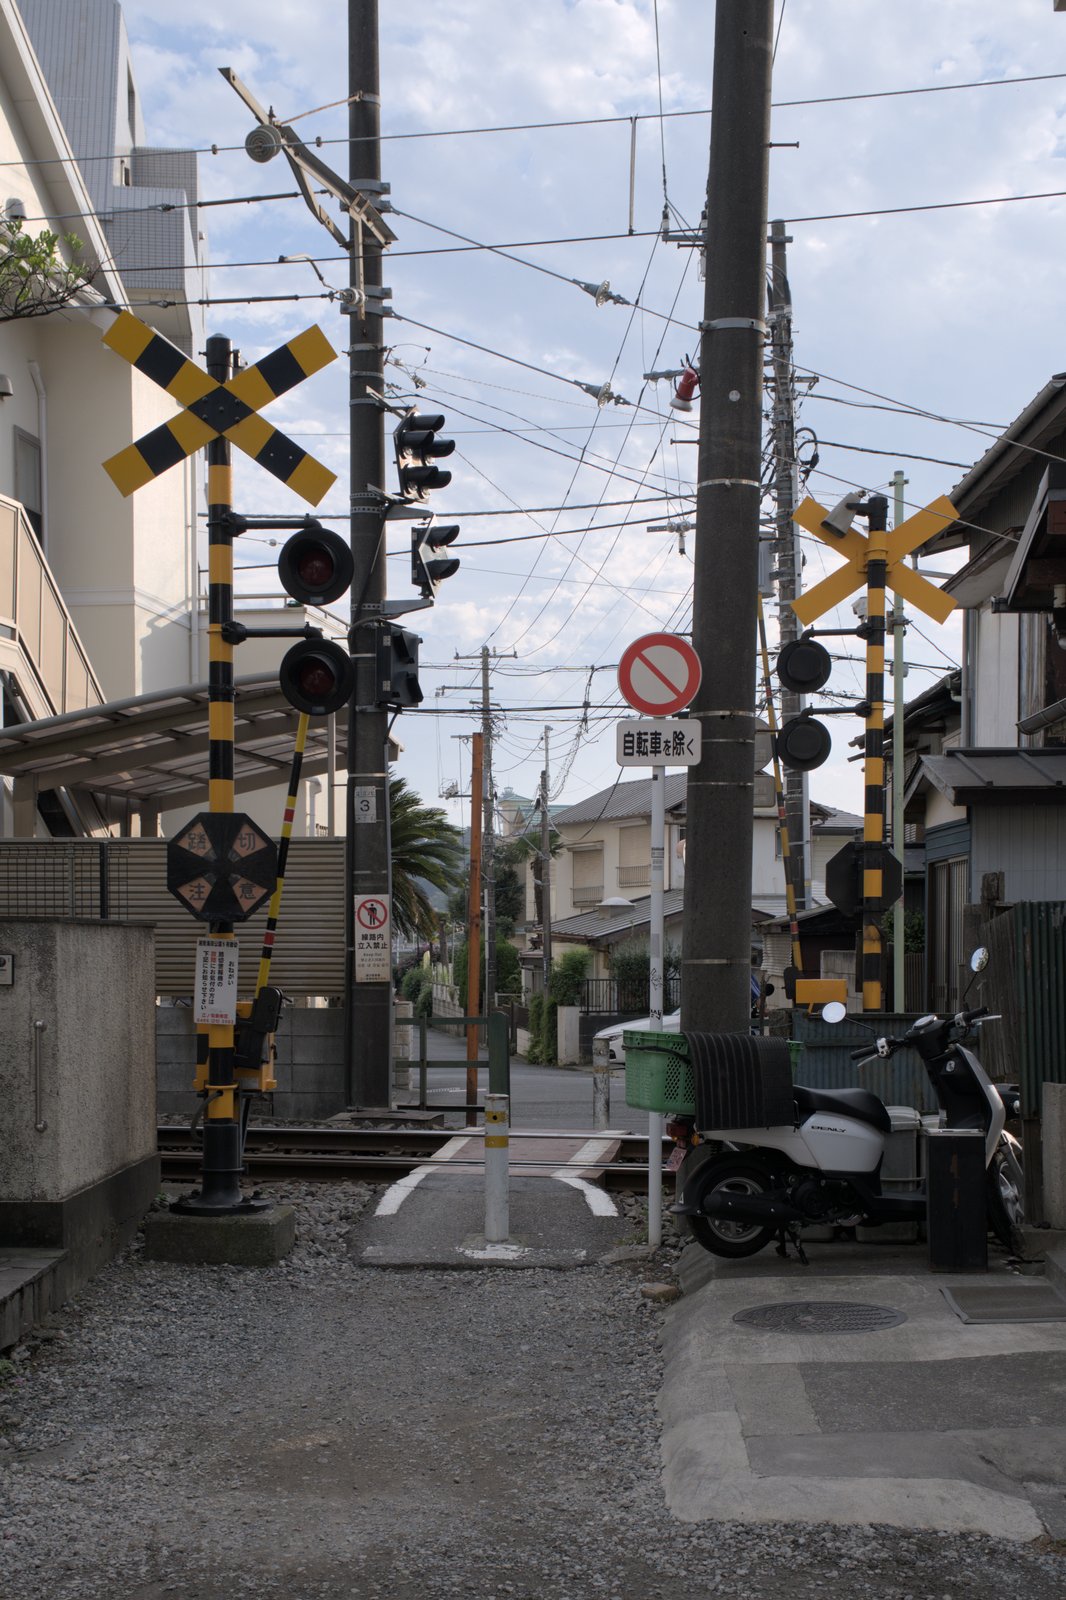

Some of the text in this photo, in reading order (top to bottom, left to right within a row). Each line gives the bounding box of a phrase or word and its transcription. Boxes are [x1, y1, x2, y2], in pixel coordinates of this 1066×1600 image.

[623, 730, 694, 757] 自転車を除く
[360, 799, 370, 812] 3
[187, 832, 256, 851] 踏切
[188, 882, 257, 901] 注意
